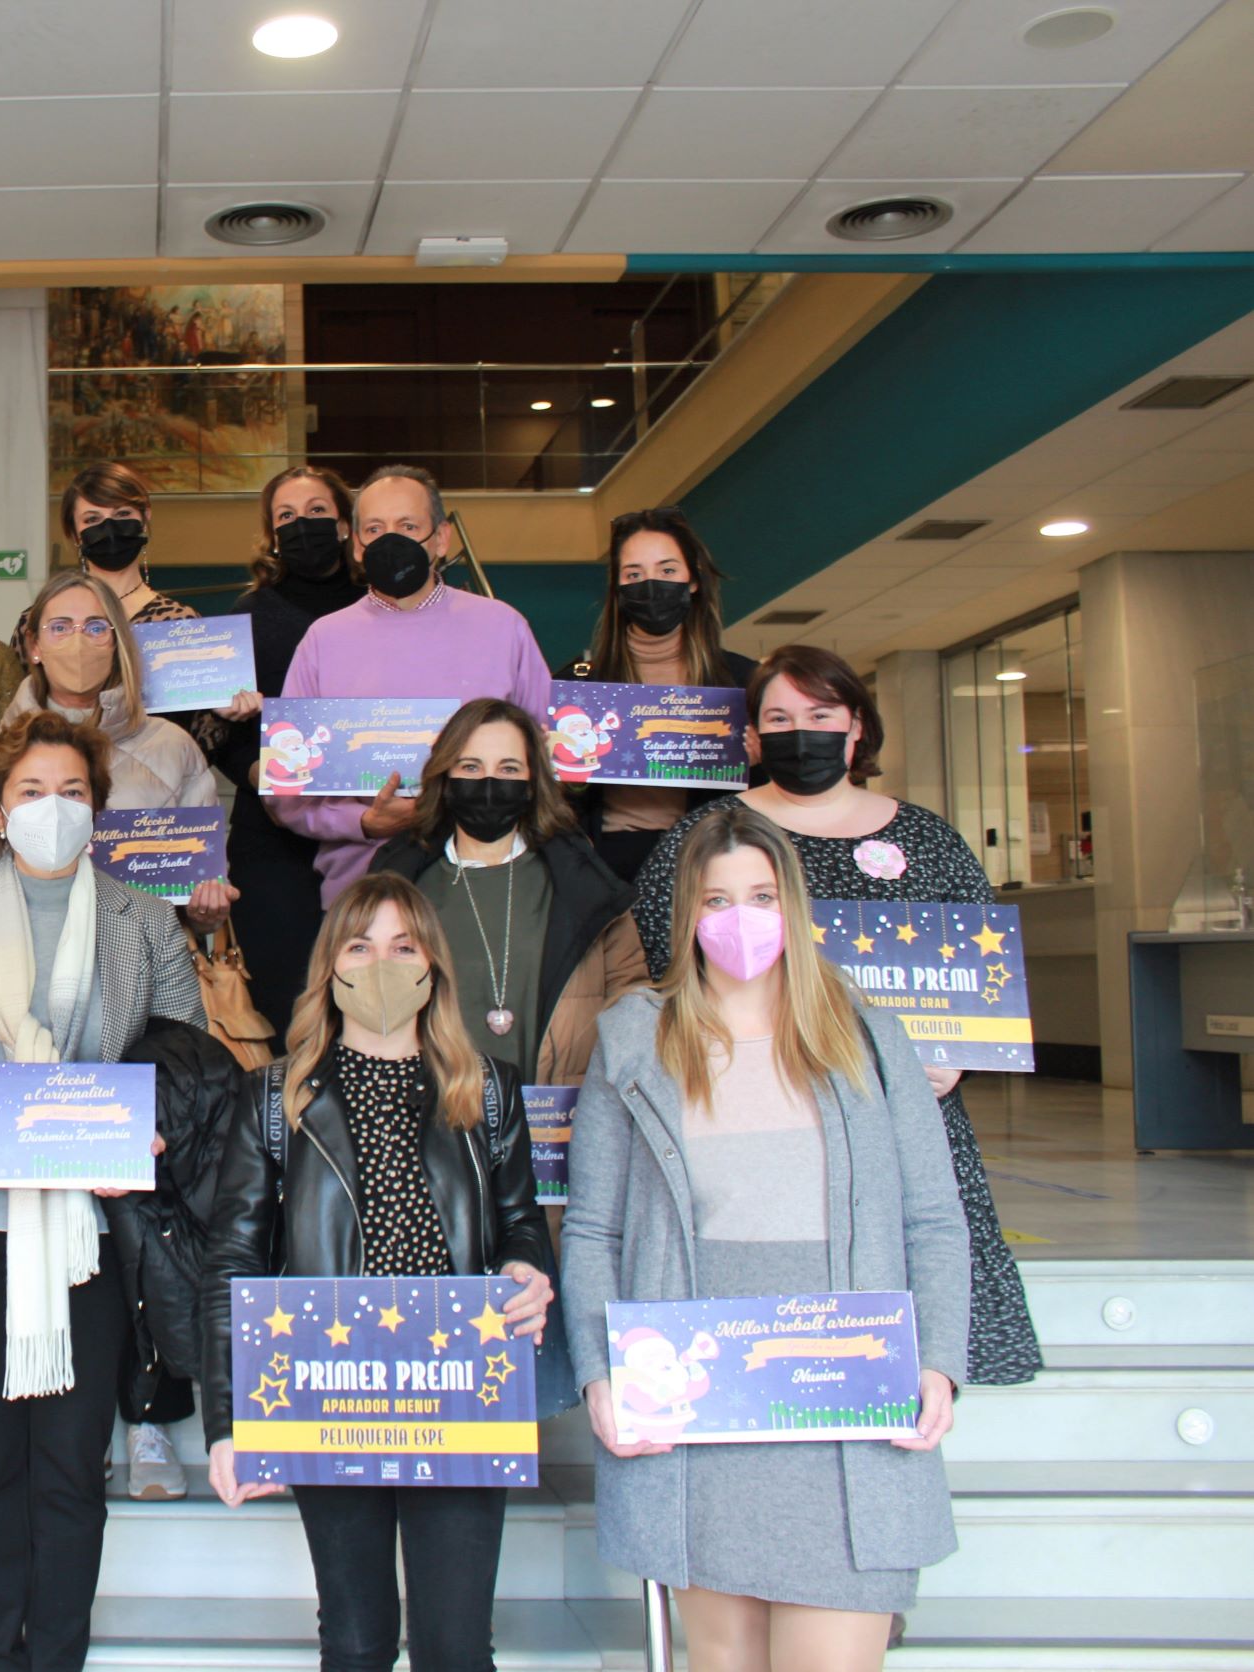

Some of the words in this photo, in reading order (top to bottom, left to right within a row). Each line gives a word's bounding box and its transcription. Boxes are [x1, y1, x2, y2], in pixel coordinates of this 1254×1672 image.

[660, 694, 702, 704] Accèsit
[630, 706, 668, 717] Millor
[369, 716, 386, 727] del
[679, 741, 690, 749] de
[691, 740, 724, 749] belleza
[133, 816, 175, 827] Accèsit
[92, 831, 129, 842] Millor
[130, 827, 167, 838] treball
[168, 822, 218, 835] artesanal
[159, 857, 192, 868] Isabel
[913, 967, 978, 992] PREMI
[864, 996, 916, 1008] PARADOR
[920, 996, 950, 1009] GRAN
[46, 1073, 96, 1086] Accèsit
[24, 1093, 32, 1101] a
[34, 1087, 116, 1103] l'originalitat
[524, 1096, 555, 1108] ccèsit
[484, 1079, 499, 1128] GUESS
[270, 1092, 283, 1141] GUESS
[776, 1298, 838, 1316] Accèsit
[715, 1318, 771, 1338] Millor
[772, 1315, 826, 1333] treball
[826, 1309, 904, 1330] artesanal
[294, 1360, 388, 1391] PRIMER
[396, 1360, 474, 1391] PREMI
[322, 1398, 390, 1413] APARADOR
[394, 1398, 441, 1413] MENUT
[320, 1425, 409, 1449] PELUQUERÍA
[413, 1428, 445, 1446] ESPE
